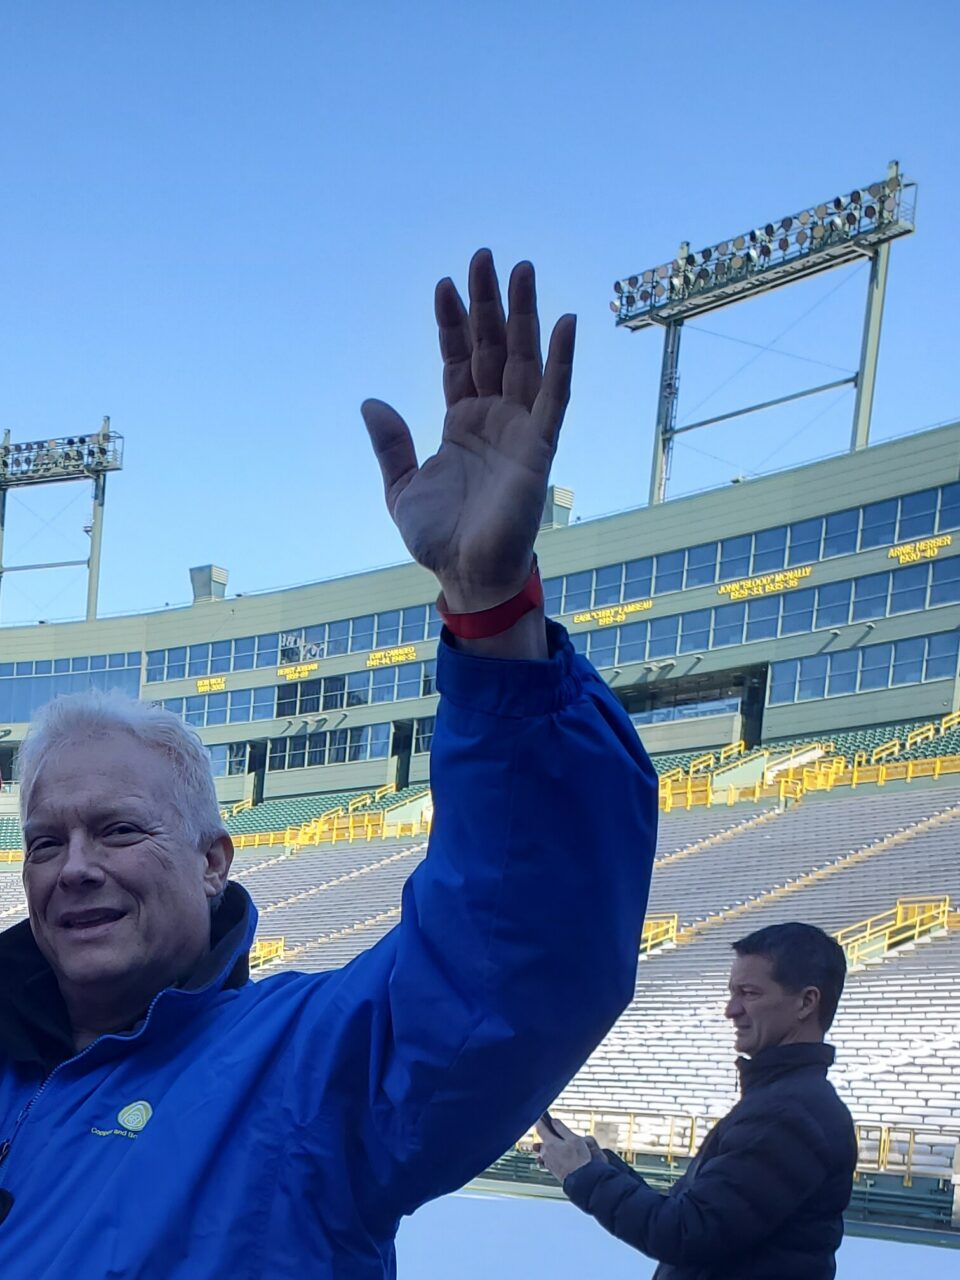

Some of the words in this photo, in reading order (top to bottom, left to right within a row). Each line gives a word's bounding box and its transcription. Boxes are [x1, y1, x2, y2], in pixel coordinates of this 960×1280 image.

[887, 543, 915, 558] ARNIE
[916, 535, 952, 552] HERBER
[717, 582, 740, 594] JOHN
[573, 613, 592, 624] EARL
[619, 600, 653, 613] LAMBEAU
